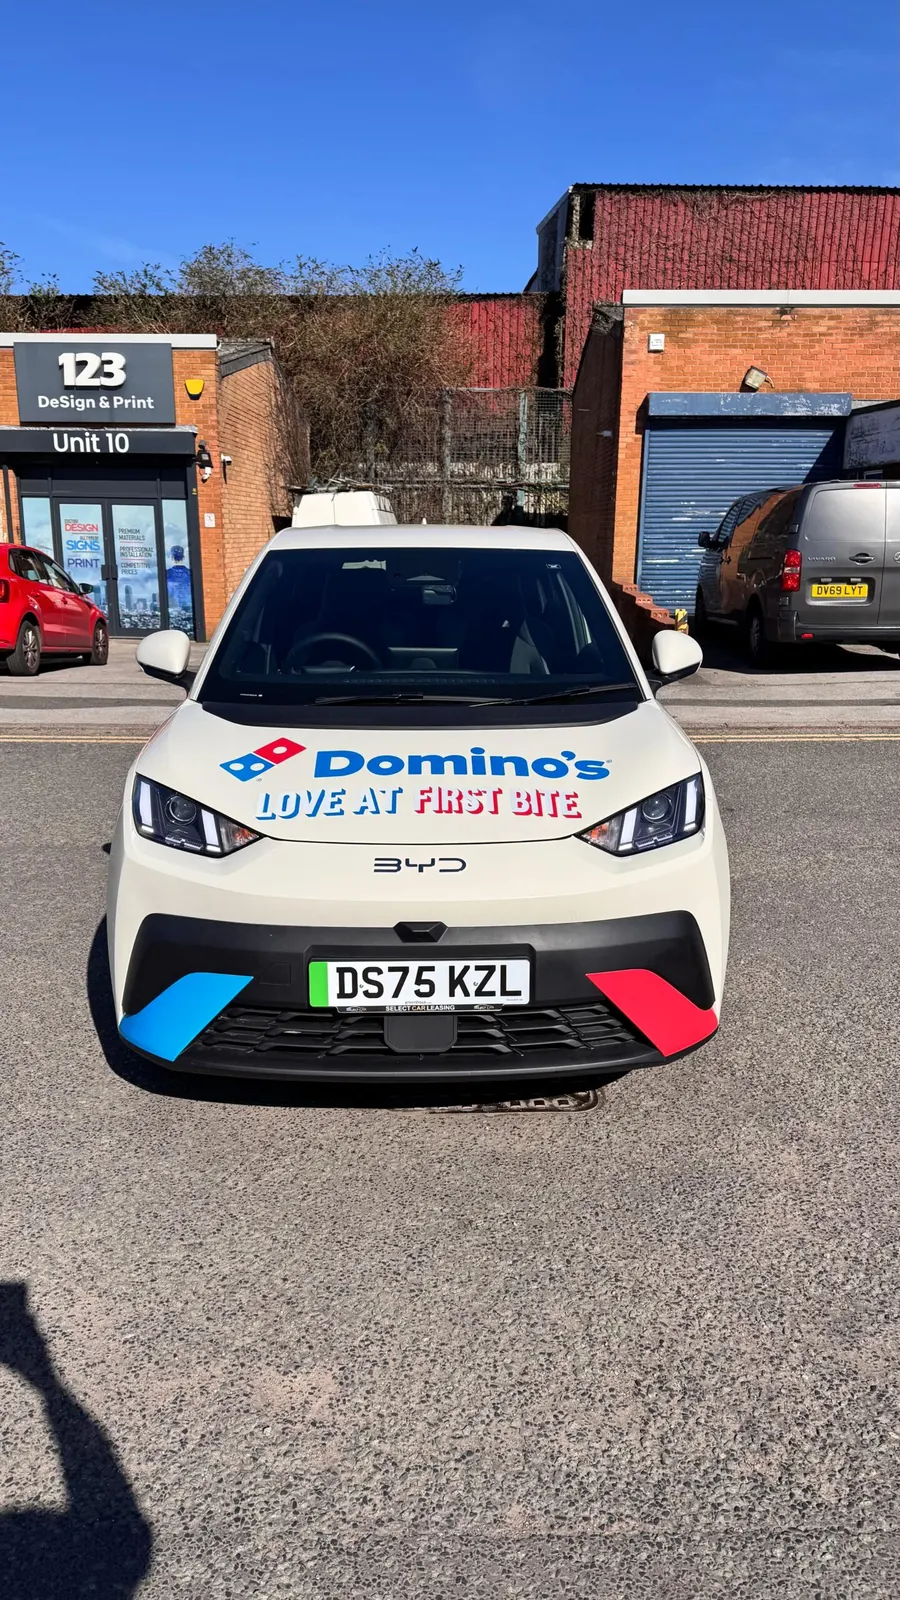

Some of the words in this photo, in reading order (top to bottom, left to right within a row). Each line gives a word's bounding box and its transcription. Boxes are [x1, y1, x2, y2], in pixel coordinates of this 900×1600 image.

[58, 352, 127, 388] 123
[37, 395, 96, 411] DeSign
[99, 396, 110, 409] &
[113, 395, 155, 409] Print
[53, 432, 101, 453] Unit
[105, 432, 130, 453] 10
[64, 523, 99, 532] DESIGN
[66, 540, 101, 551] SIGNS
[67, 558, 101, 568] PRINT
[817, 586, 842, 595] DV69
[844, 586, 864, 595] LYT
[313, 747, 611, 780] Domino's
[255, 788, 346, 820] LOVE
[352, 786, 403, 815] AT
[413, 786, 503, 815] FIRST
[511, 788, 583, 818] BITE
[373, 857, 467, 873] BYD
[336, 966, 436, 999] DS75
[449, 965, 522, 998] KZL
